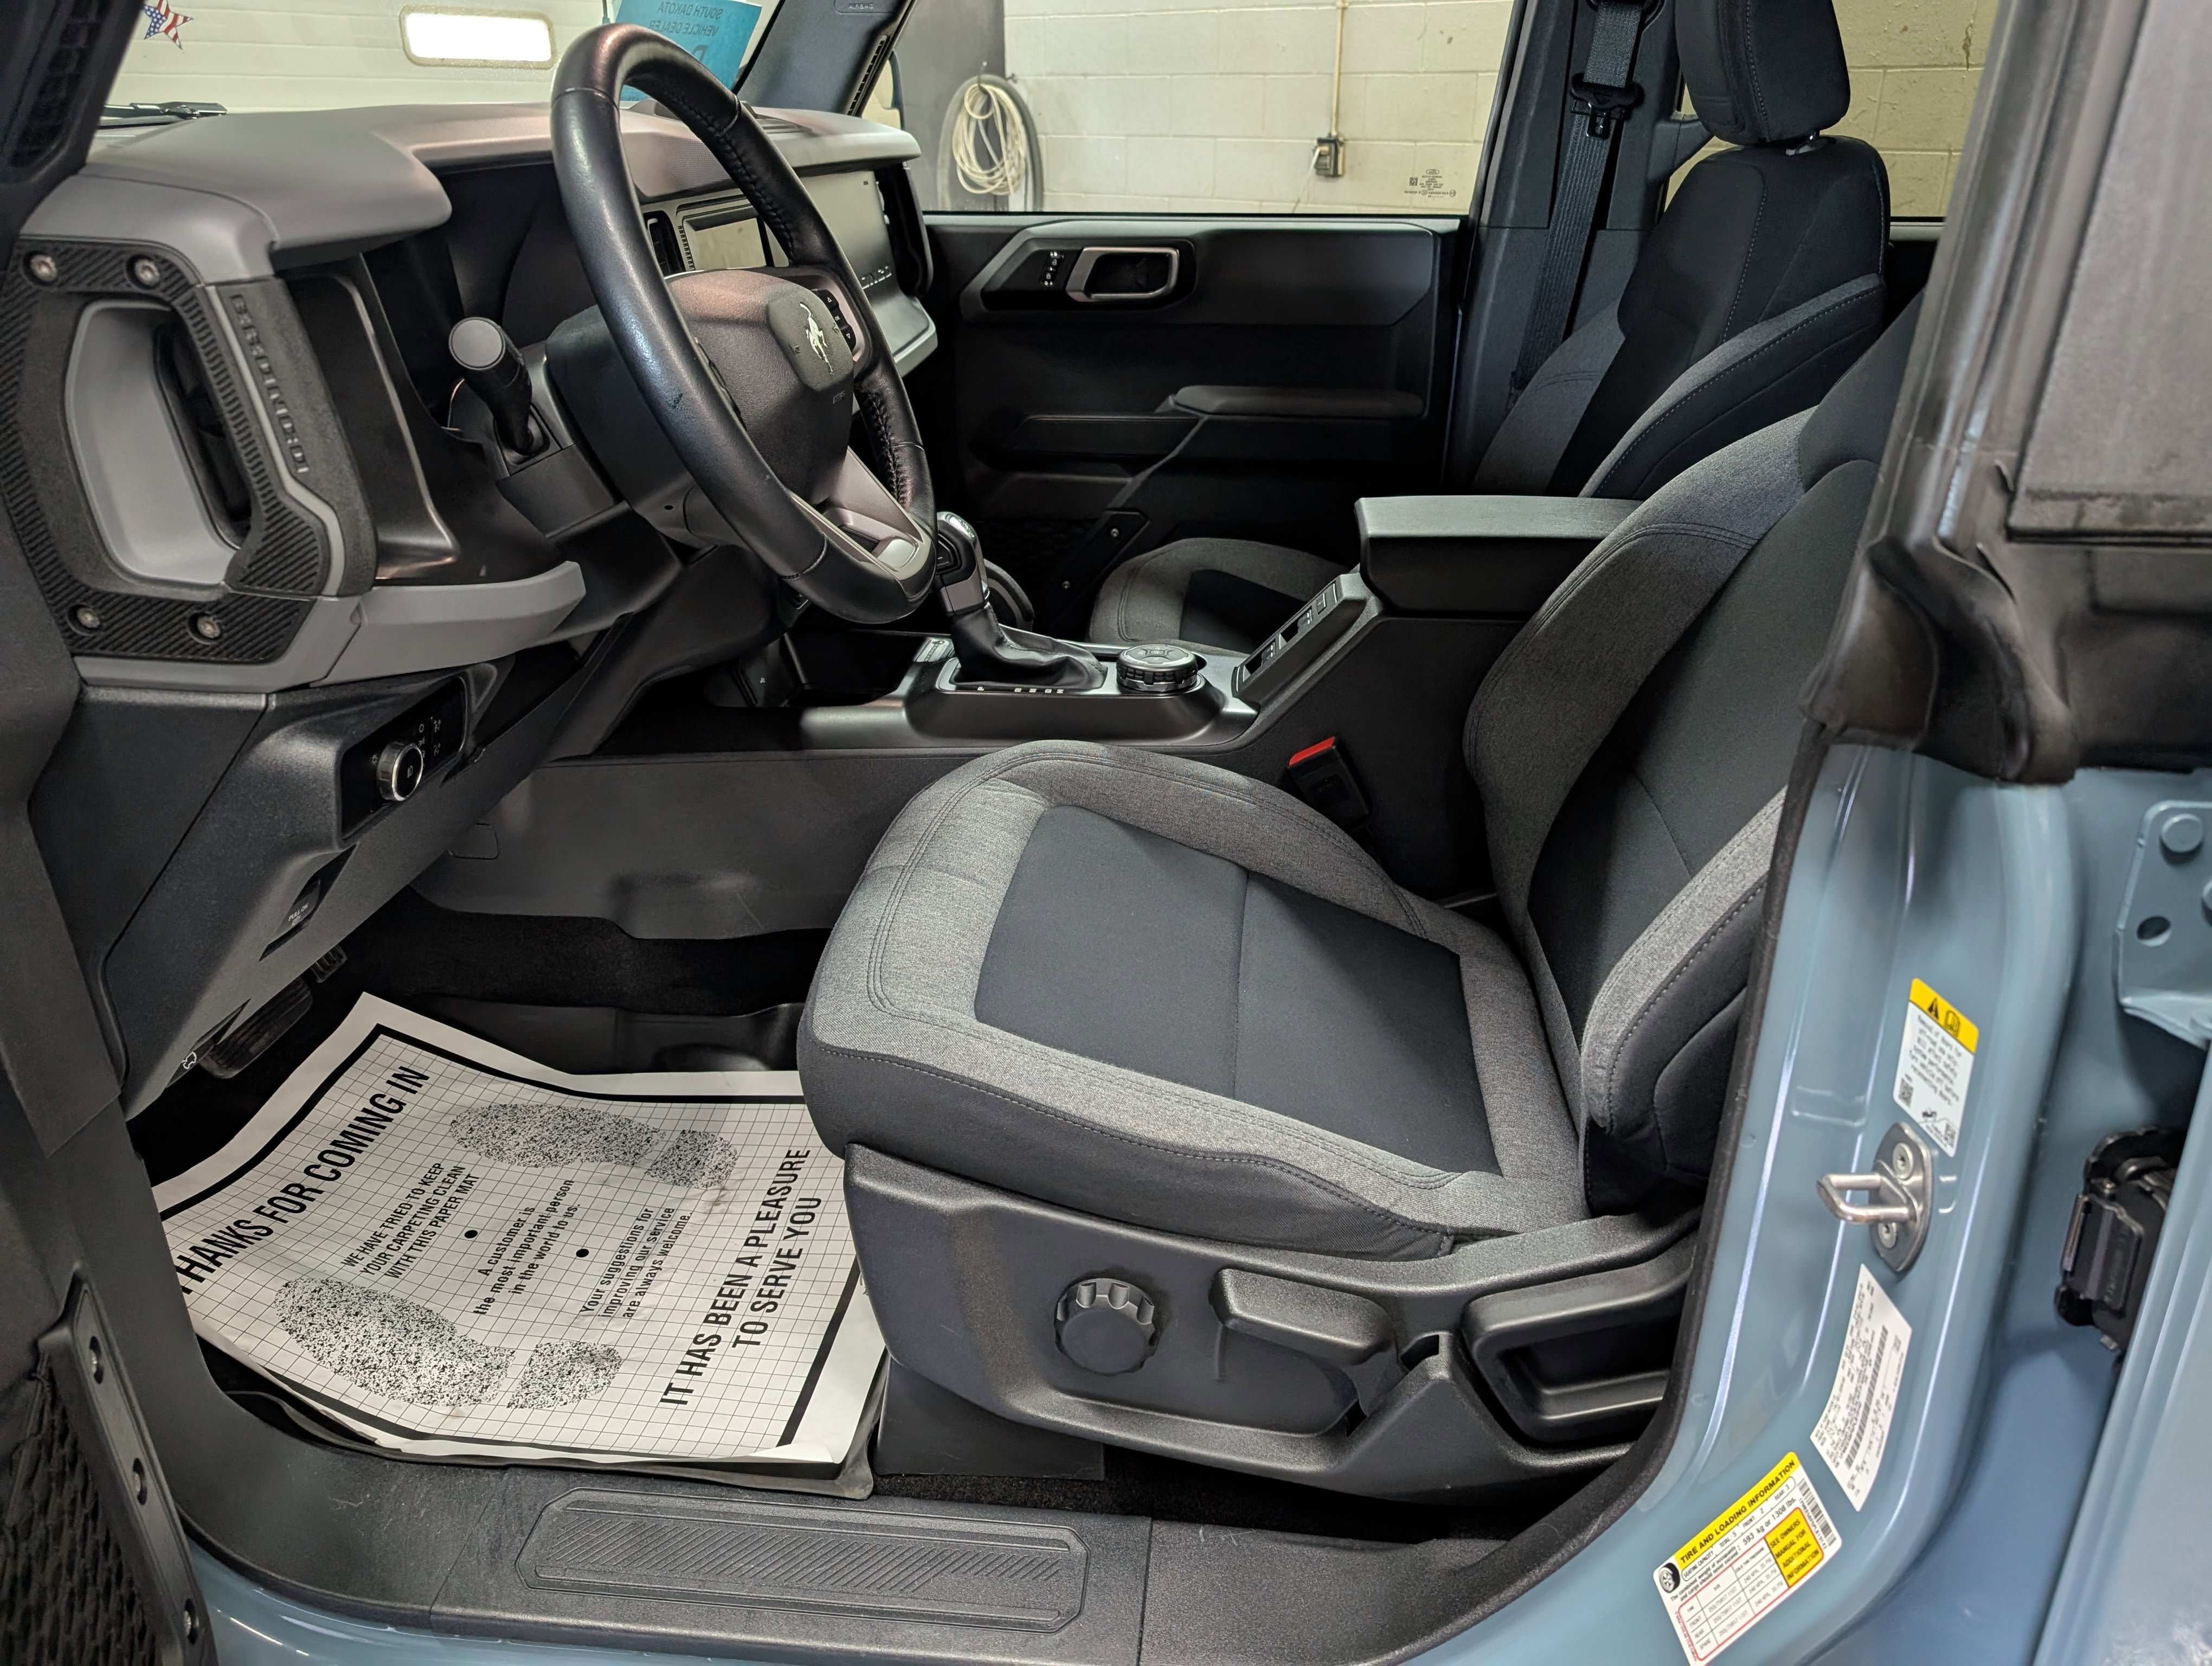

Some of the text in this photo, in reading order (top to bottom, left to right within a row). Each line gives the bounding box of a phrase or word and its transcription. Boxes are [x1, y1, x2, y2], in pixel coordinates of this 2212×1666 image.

[230, 294, 309, 473] BRONCO
[253, 1183, 325, 1223] FOR
[304, 1093, 407, 1182] COMING
[386, 1066, 430, 1094] IN
[340, 1163, 444, 1267] WE HAVE TRIED TO KEEP
[359, 1166, 466, 1275] YOUR CARPETING CLEAN
[384, 1174, 479, 1279] WITH THIS PAPER MAT
[473, 1180, 574, 1315] the most important person
[487, 1218, 526, 1265] customer
[519, 1207, 535, 1215] is
[508, 1204, 581, 1295] in the world to us.
[580, 1208, 653, 1312] Your suggestions for
[598, 1208, 674, 1317] improving our service
[622, 1212, 693, 1317] are always welcome.
[660, 1150, 811, 1405] IT HAS BEEN A PLEASURE
[731, 1197, 821, 1348] TO SERVE YOU
[1681, 1460, 1795, 1562] TIRE AND LOADING INFORMATION
[1743, 1533, 1754, 1545] 593
[1756, 1526, 1764, 1534] kg
[1772, 1505, 1786, 1520] 1308
[1770, 1519, 1800, 1548] SEE OWNERS
[1775, 1529, 1806, 1559] MANUAL FOR
[1783, 1542, 1811, 1568] ADDITIONAL
[1679, 1578, 1697, 1595] combined
[1698, 1567, 1711, 1579] weight
[1716, 1546, 1735, 1564] occupants
[1684, 1565, 1697, 1577] SEATING
[1688, 1584, 1699, 1594] cargo
[1700, 1572, 1712, 1585] should
[1713, 1563, 1723, 1573] never
[1725, 1550, 1738, 1564] exceed
[1787, 1549, 1819, 1580] INFORMATION
